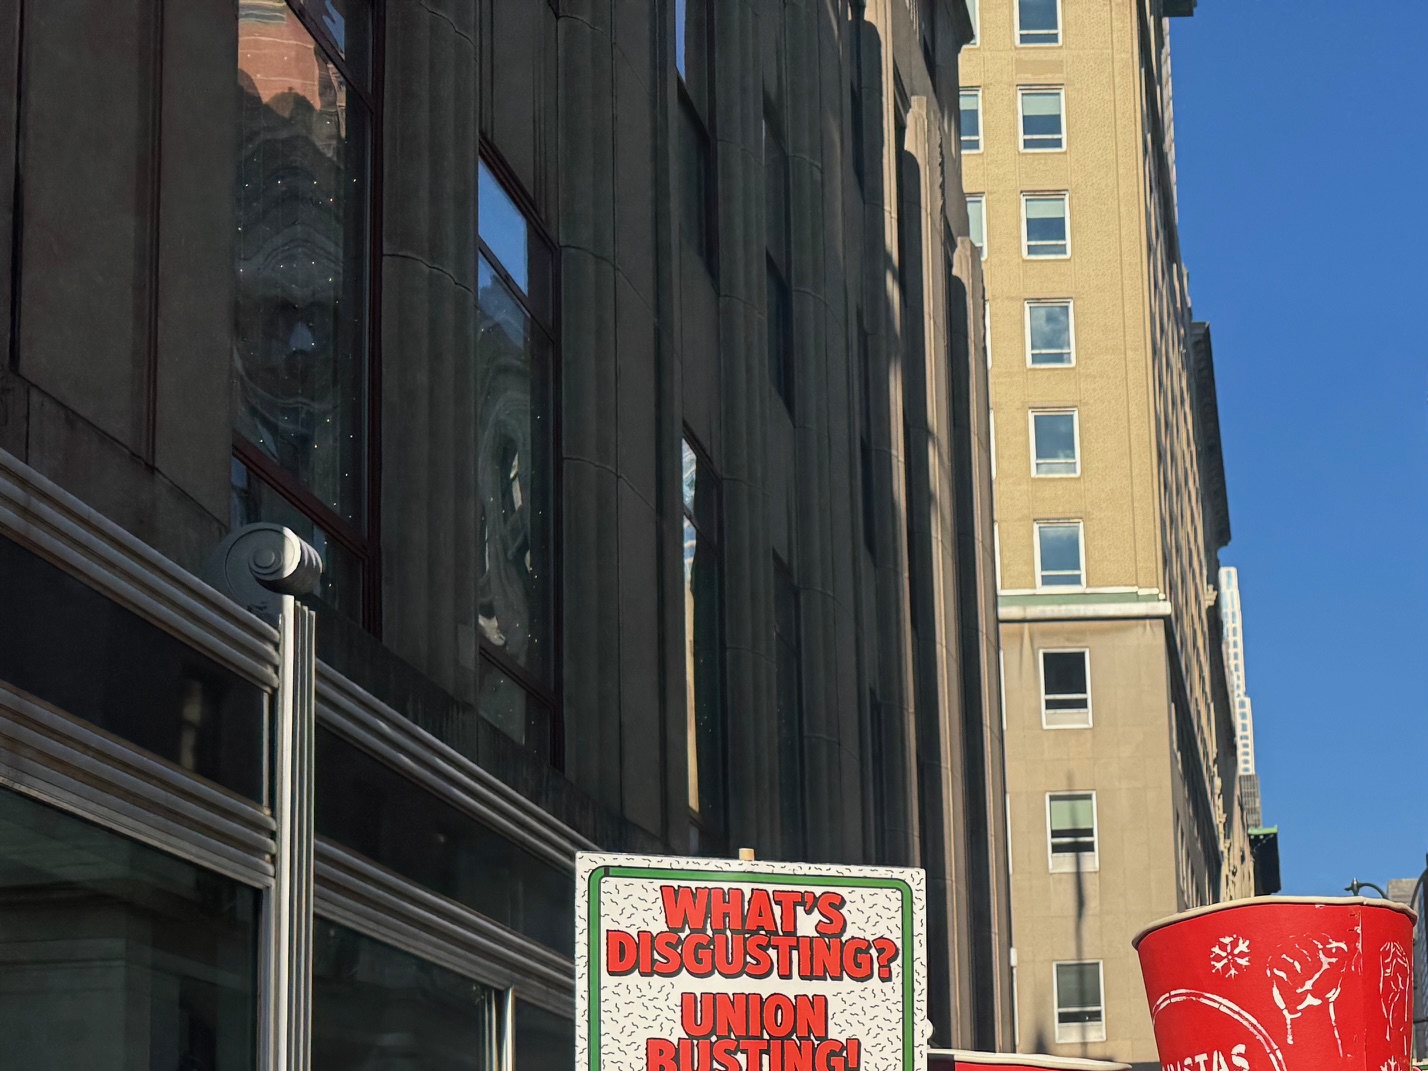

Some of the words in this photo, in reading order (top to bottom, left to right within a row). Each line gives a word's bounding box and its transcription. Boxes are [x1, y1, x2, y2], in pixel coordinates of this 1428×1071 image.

[660, 885, 846, 937] WHAT'S
[606, 930, 899, 982] DISGUSTING?
[681, 992, 829, 1039] UNION
